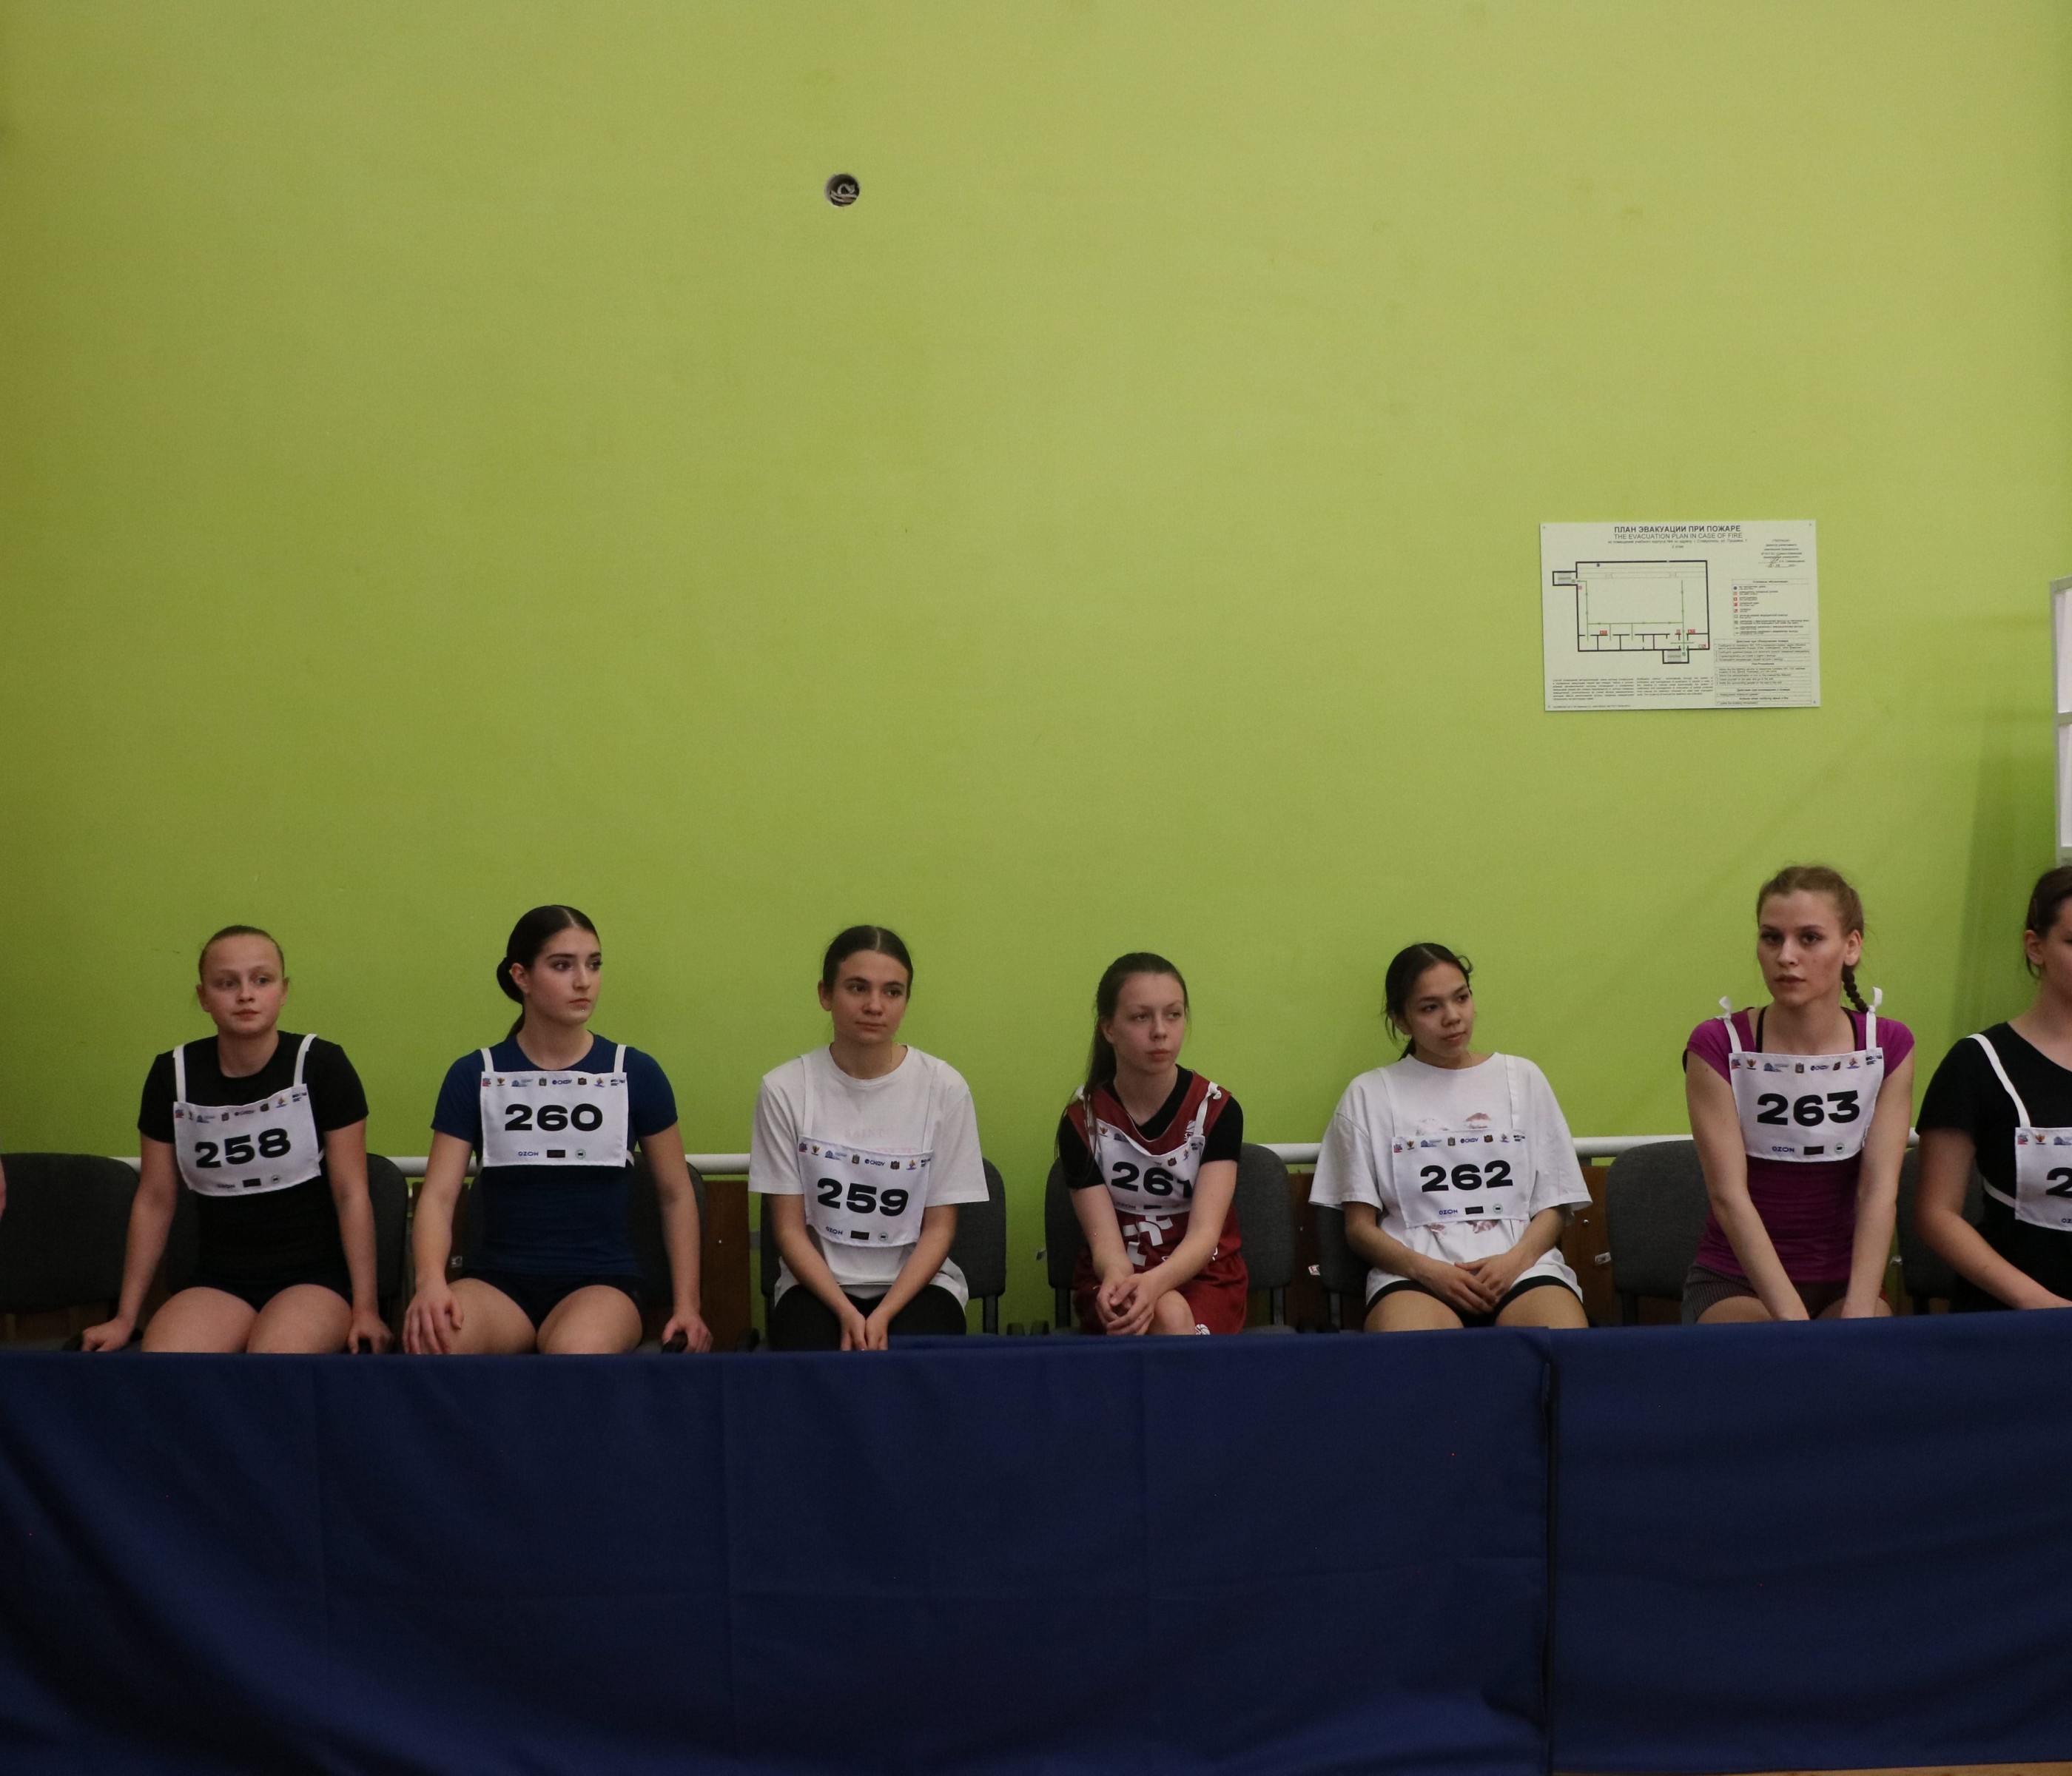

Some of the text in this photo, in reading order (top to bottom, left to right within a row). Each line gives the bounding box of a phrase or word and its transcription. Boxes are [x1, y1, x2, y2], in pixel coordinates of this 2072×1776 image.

[505, 1103, 603, 1131] 260
[1757, 1090, 1860, 1126] 263
[195, 1128, 292, 1168] 258
[1111, 1161, 1193, 1199] 261
[1420, 1160, 1513, 1192] 262
[2046, 1167, 2072, 1199] 2
[817, 1177, 909, 1217] 259
[825, 1226, 843, 1235] OZON
